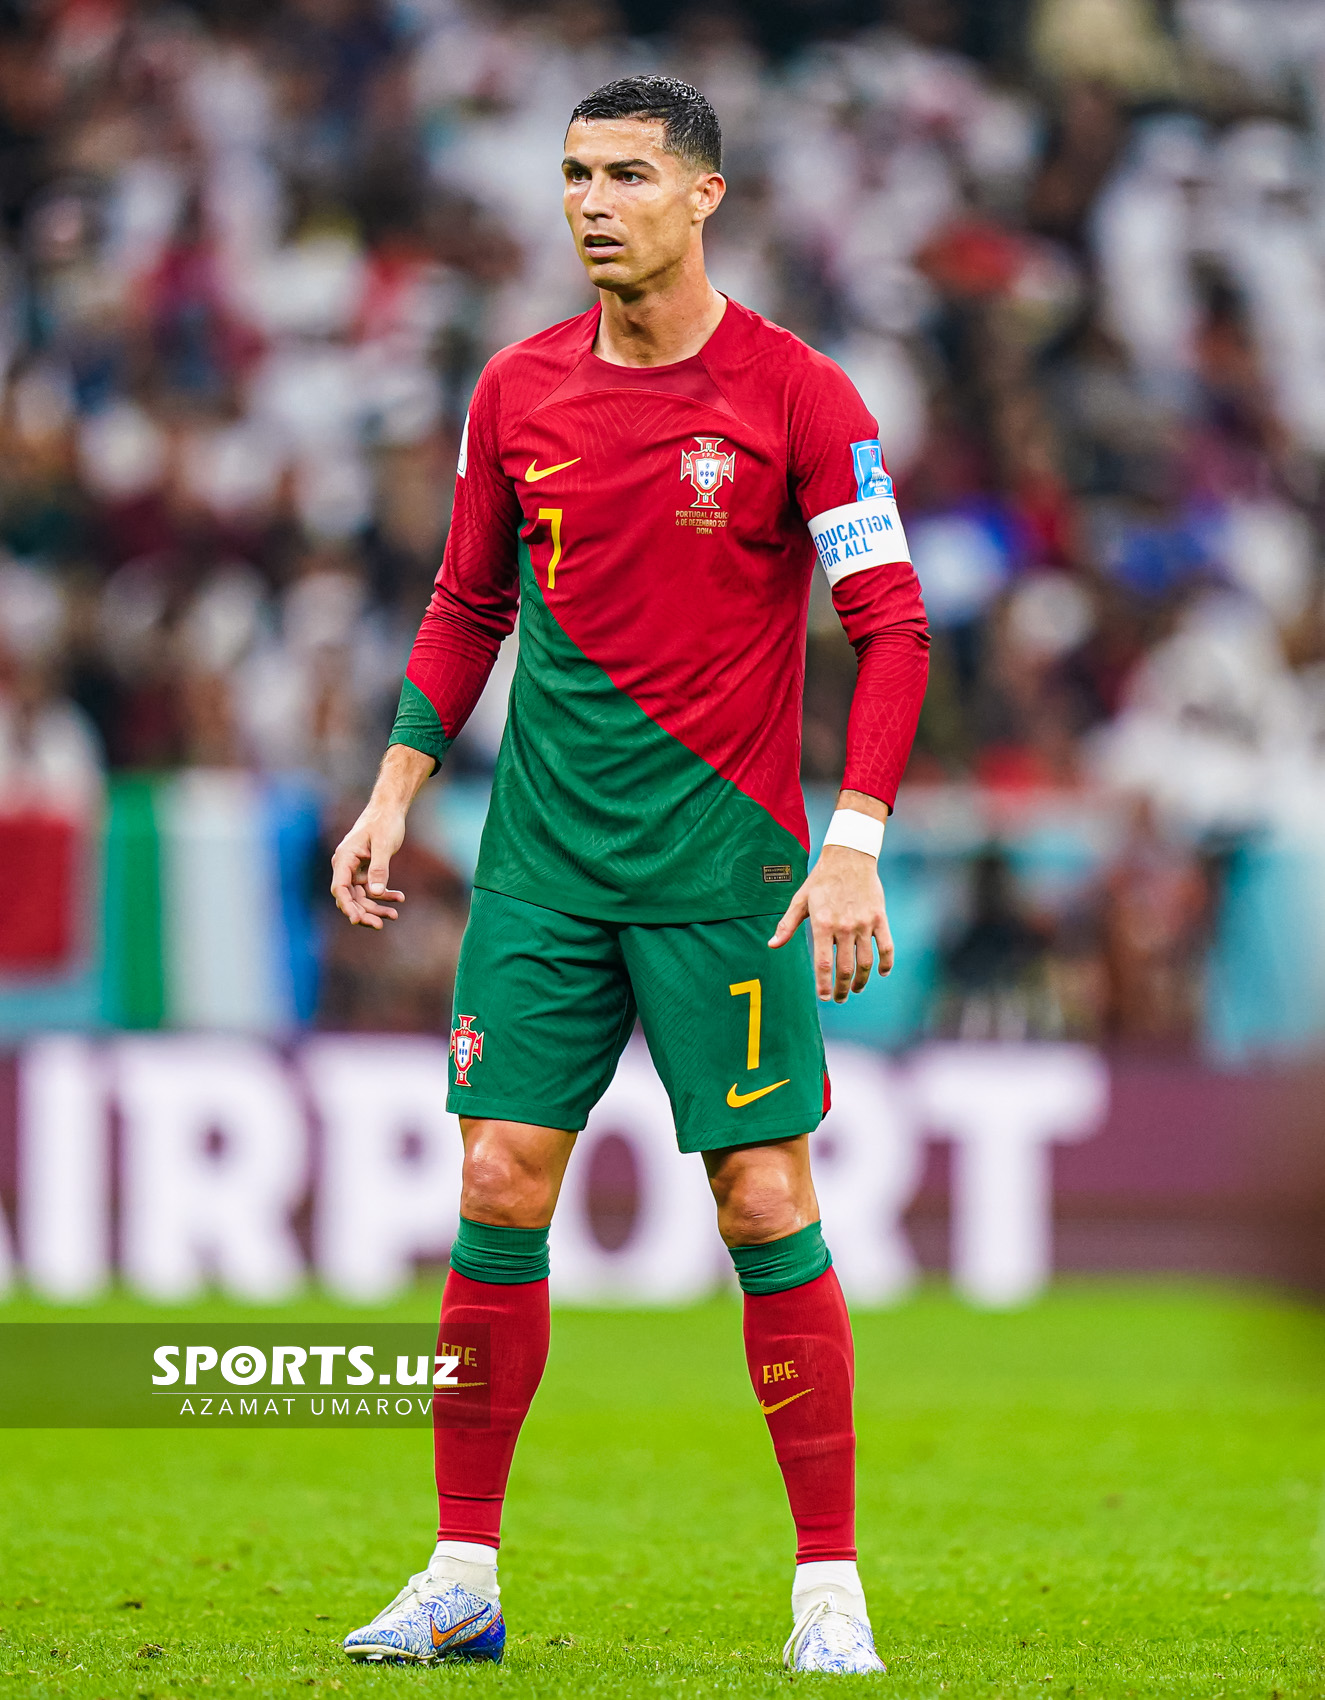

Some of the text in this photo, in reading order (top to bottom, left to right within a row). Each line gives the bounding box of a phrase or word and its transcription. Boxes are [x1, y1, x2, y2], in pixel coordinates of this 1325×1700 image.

[675, 510, 708, 519] PORTUGAL
[680, 519, 688, 527] DE
[688, 519, 717, 528] DEZEMBRO
[696, 527, 713, 535] DOHA
[538, 508, 563, 590] 7
[814, 514, 893, 555] EDUCATION
[821, 537, 873, 571] FOR ALL
[729, 978, 762, 1070] 7
[0, 1035, 1108, 1308] IRPORT
